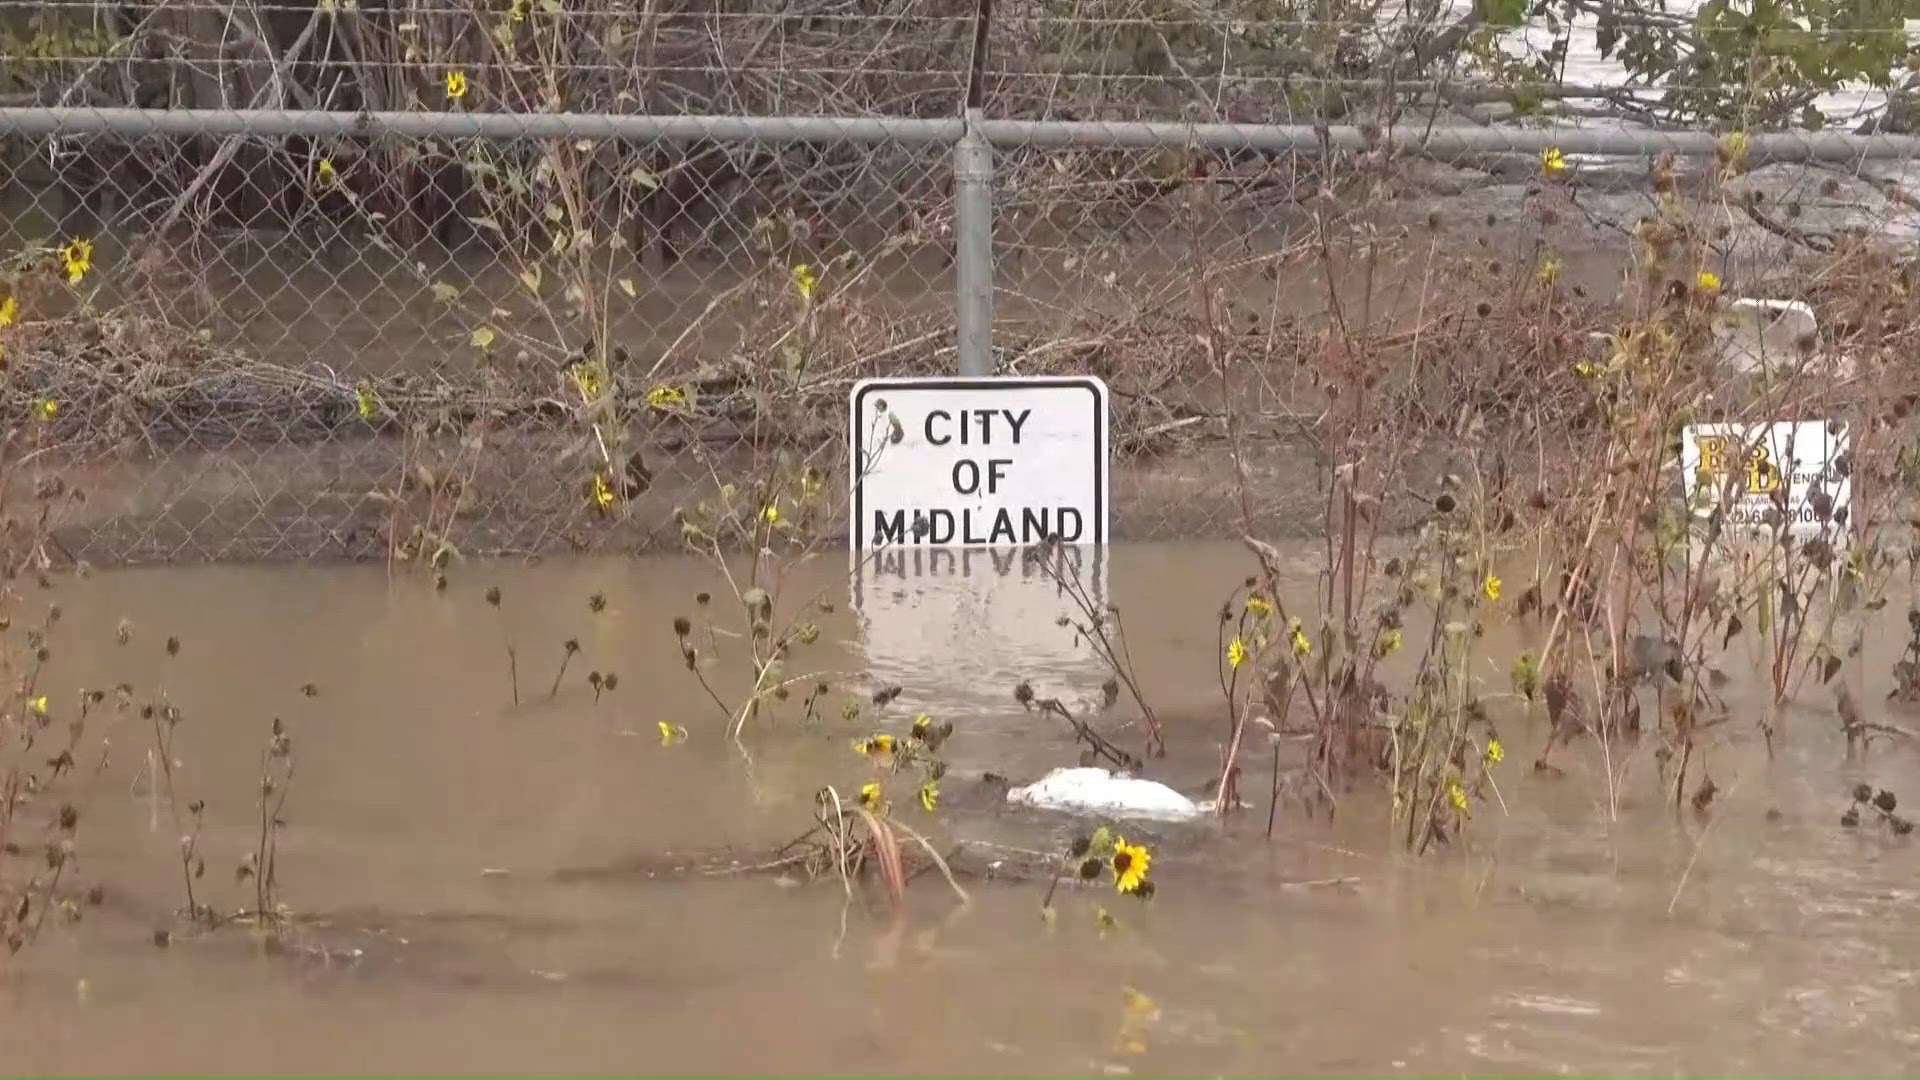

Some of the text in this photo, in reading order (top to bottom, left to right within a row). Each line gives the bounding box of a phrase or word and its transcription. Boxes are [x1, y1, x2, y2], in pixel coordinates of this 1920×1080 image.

[924, 409, 1032, 446] CITY
[952, 459, 1013, 495] OF
[874, 507, 1083, 545] MIDLAND
